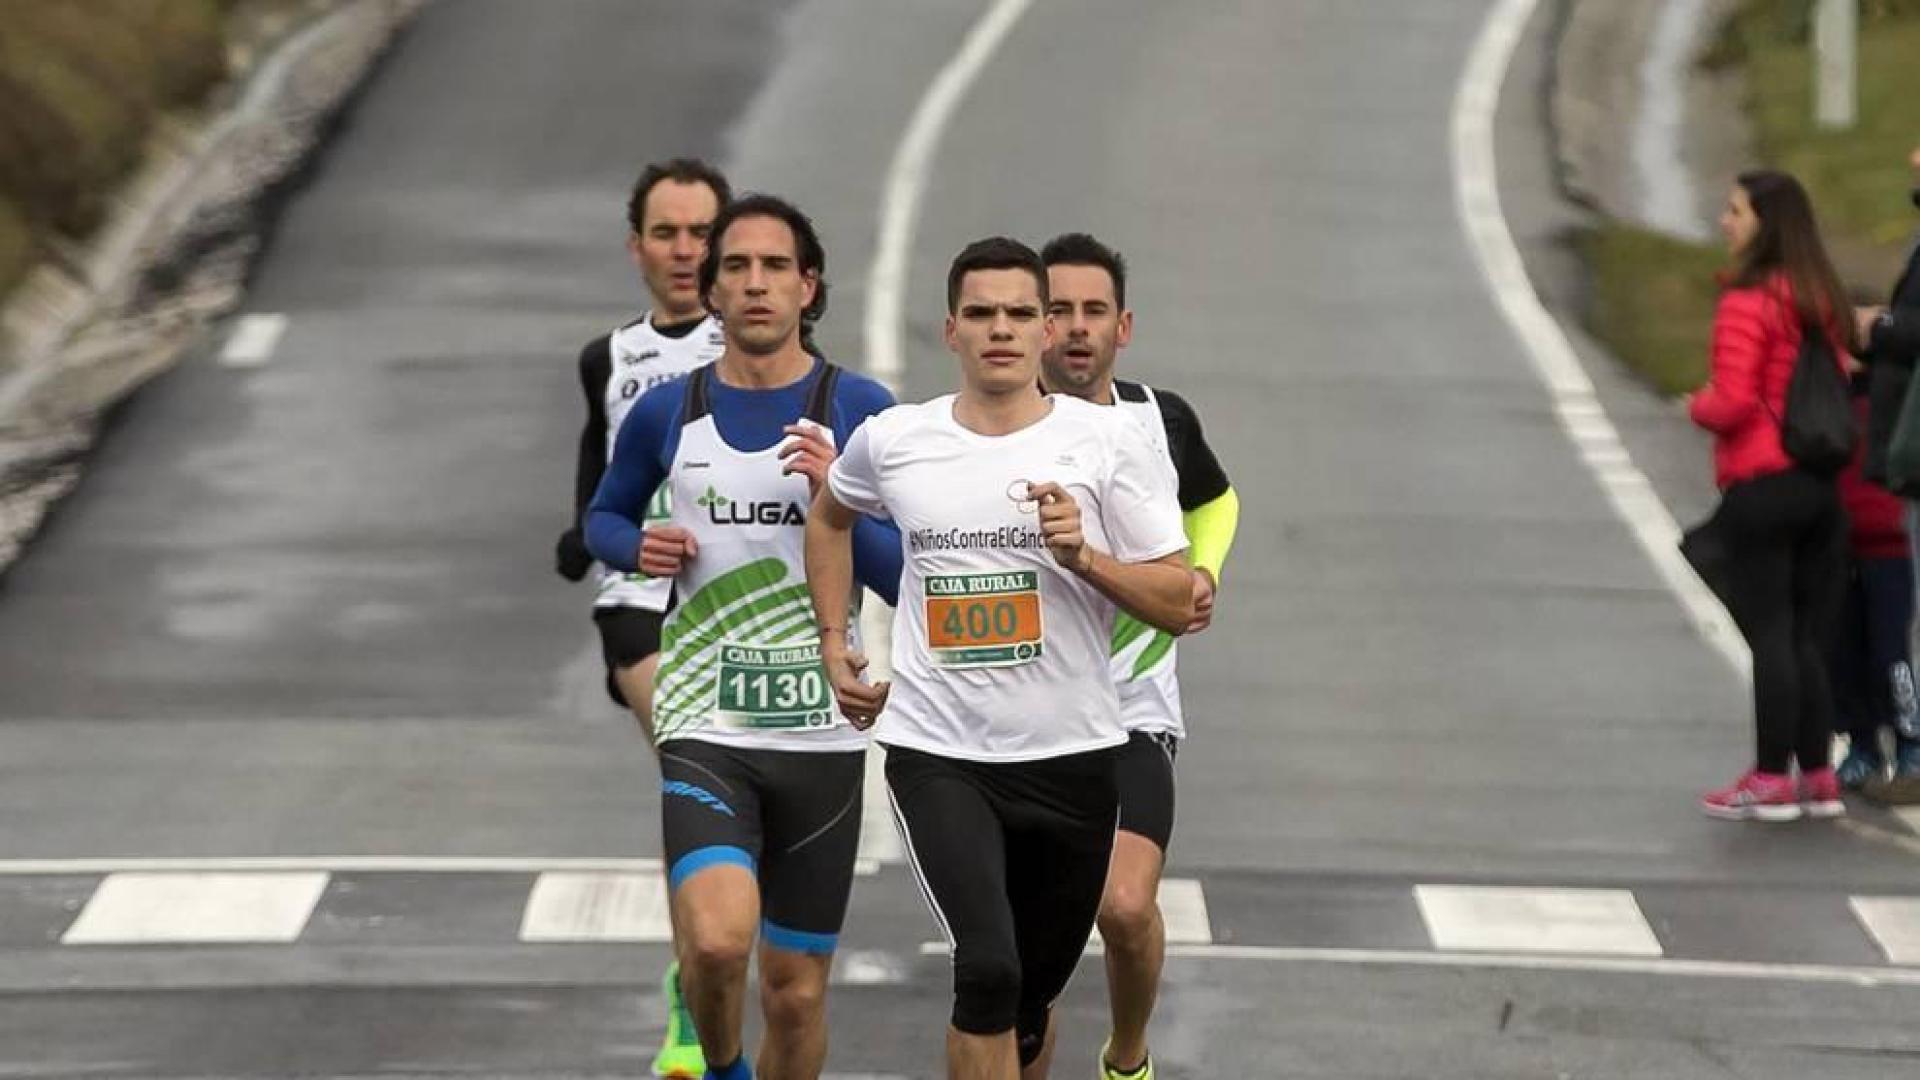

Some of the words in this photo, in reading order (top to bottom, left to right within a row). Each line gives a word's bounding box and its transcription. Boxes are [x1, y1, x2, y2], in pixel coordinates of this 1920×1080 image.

[968, 573, 1031, 593] RURAL
[943, 602, 1017, 640] 400
[768, 646, 822, 664] RURAL
[729, 671, 822, 709] 1130
